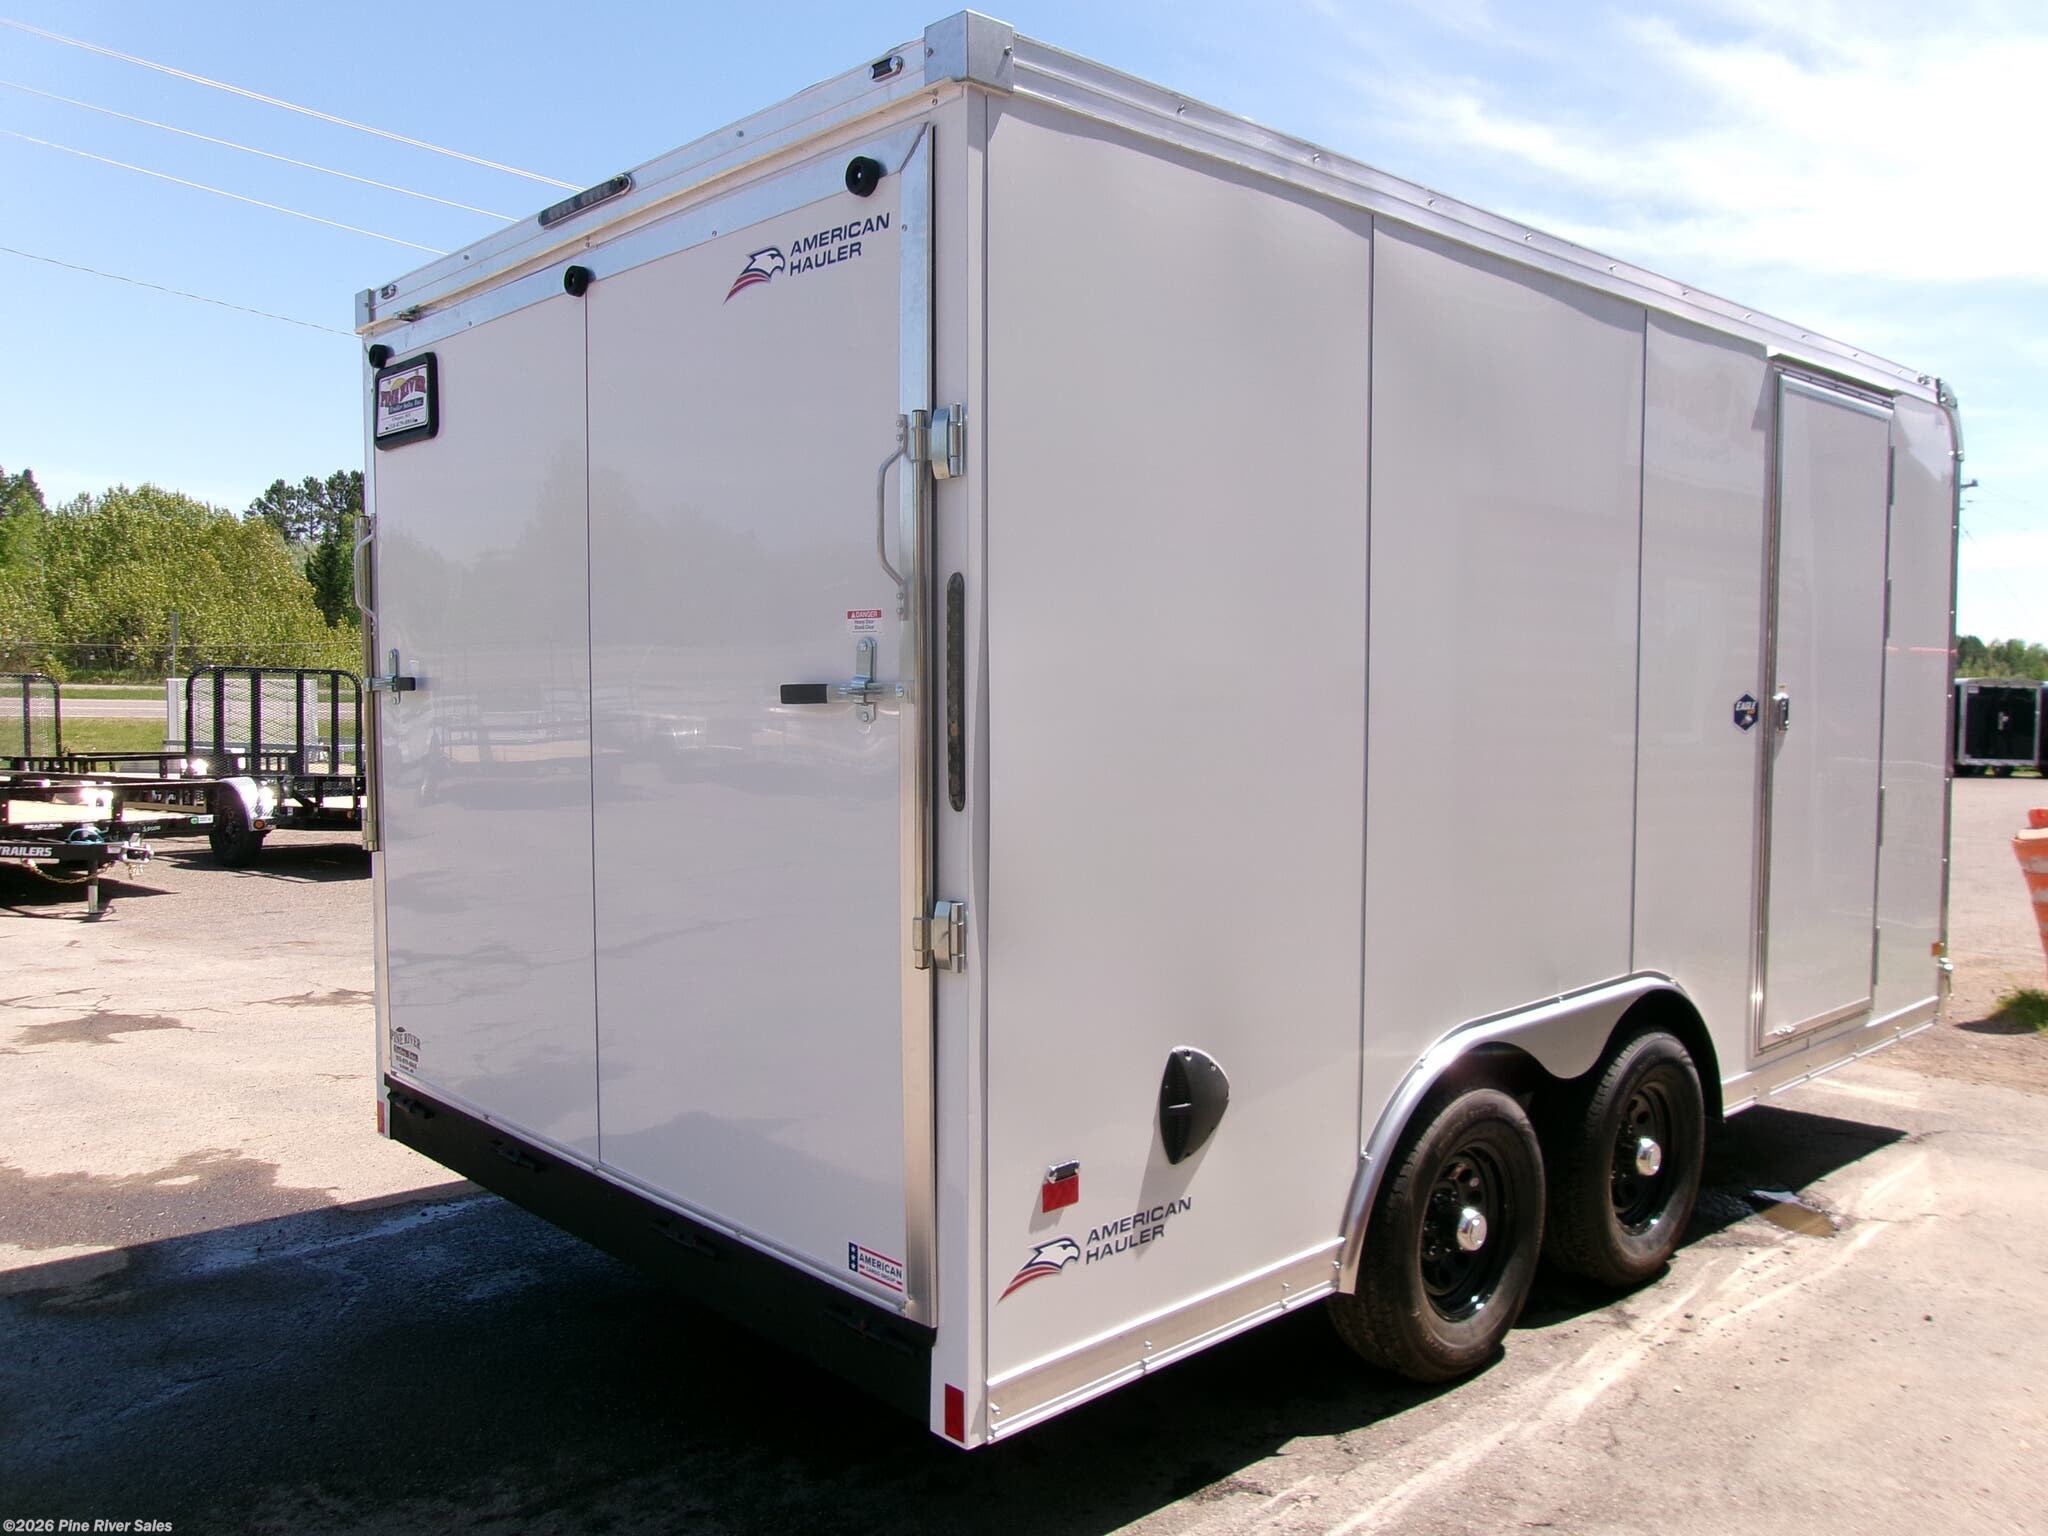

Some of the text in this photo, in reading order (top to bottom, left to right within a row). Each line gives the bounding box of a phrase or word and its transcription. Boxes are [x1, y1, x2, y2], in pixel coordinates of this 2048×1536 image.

[790, 213, 890, 257] AMERICAN
[789, 241, 862, 276] HAULER
[380, 375, 427, 408] PINE RIVER
[855, 610, 878, 619] DANGER
[404, 1032, 421, 1051] RIVER
[1086, 1196, 1192, 1246] AMERICAN
[1085, 1224, 1165, 1265] HAULER
[859, 1253, 903, 1279] AMERICAN
